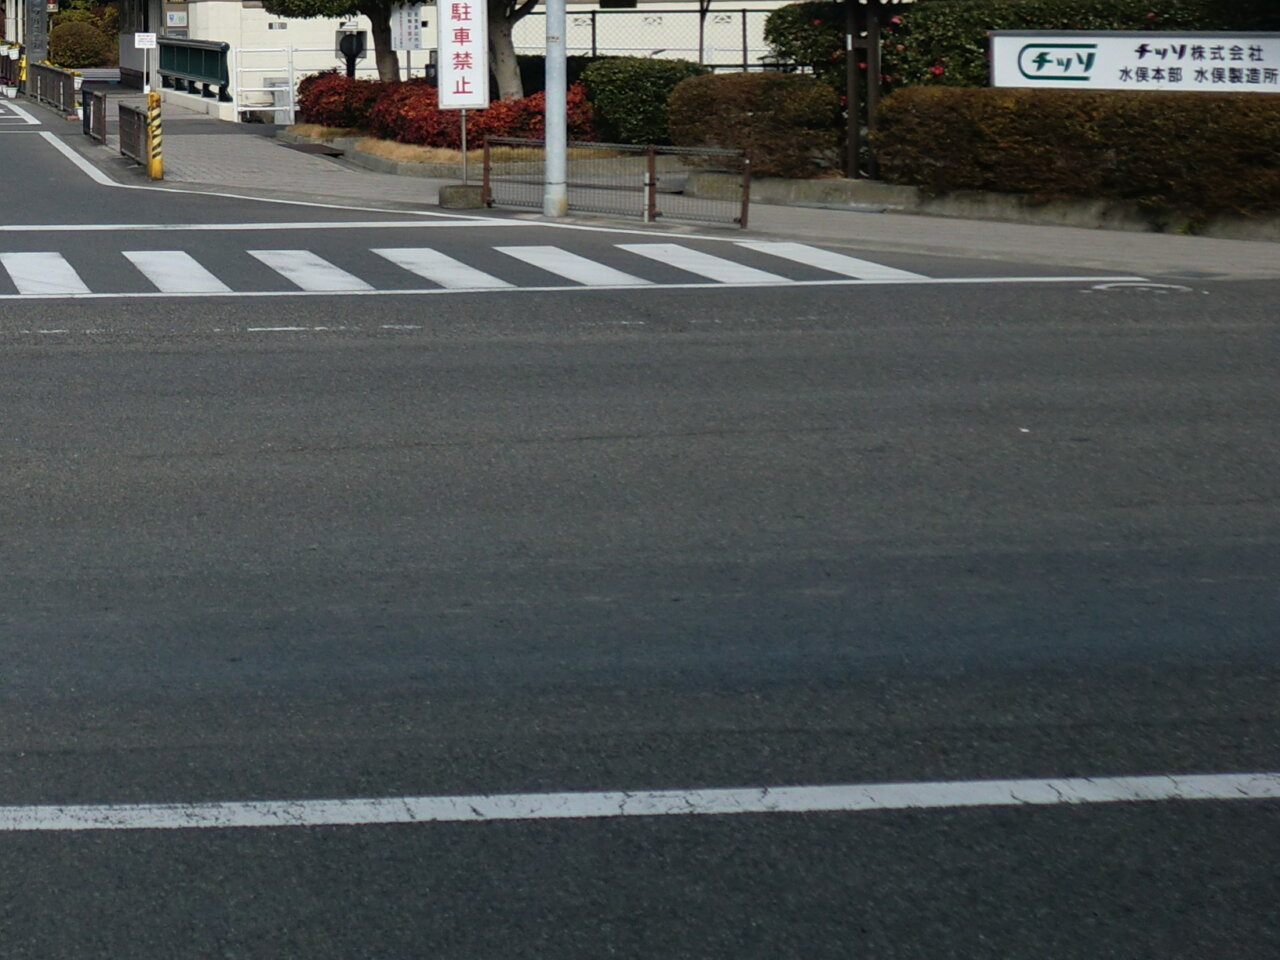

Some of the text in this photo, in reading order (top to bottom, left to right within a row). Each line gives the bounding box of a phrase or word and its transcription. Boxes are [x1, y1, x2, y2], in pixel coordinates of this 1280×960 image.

[451, 2, 473, 95] 駐車禁止
[1134, 43, 1265, 62] チッソ株式会社
[1031, 51, 1097, 73] チッソ
[1118, 67, 1279, 85] 水俣本部 水俣製造所
